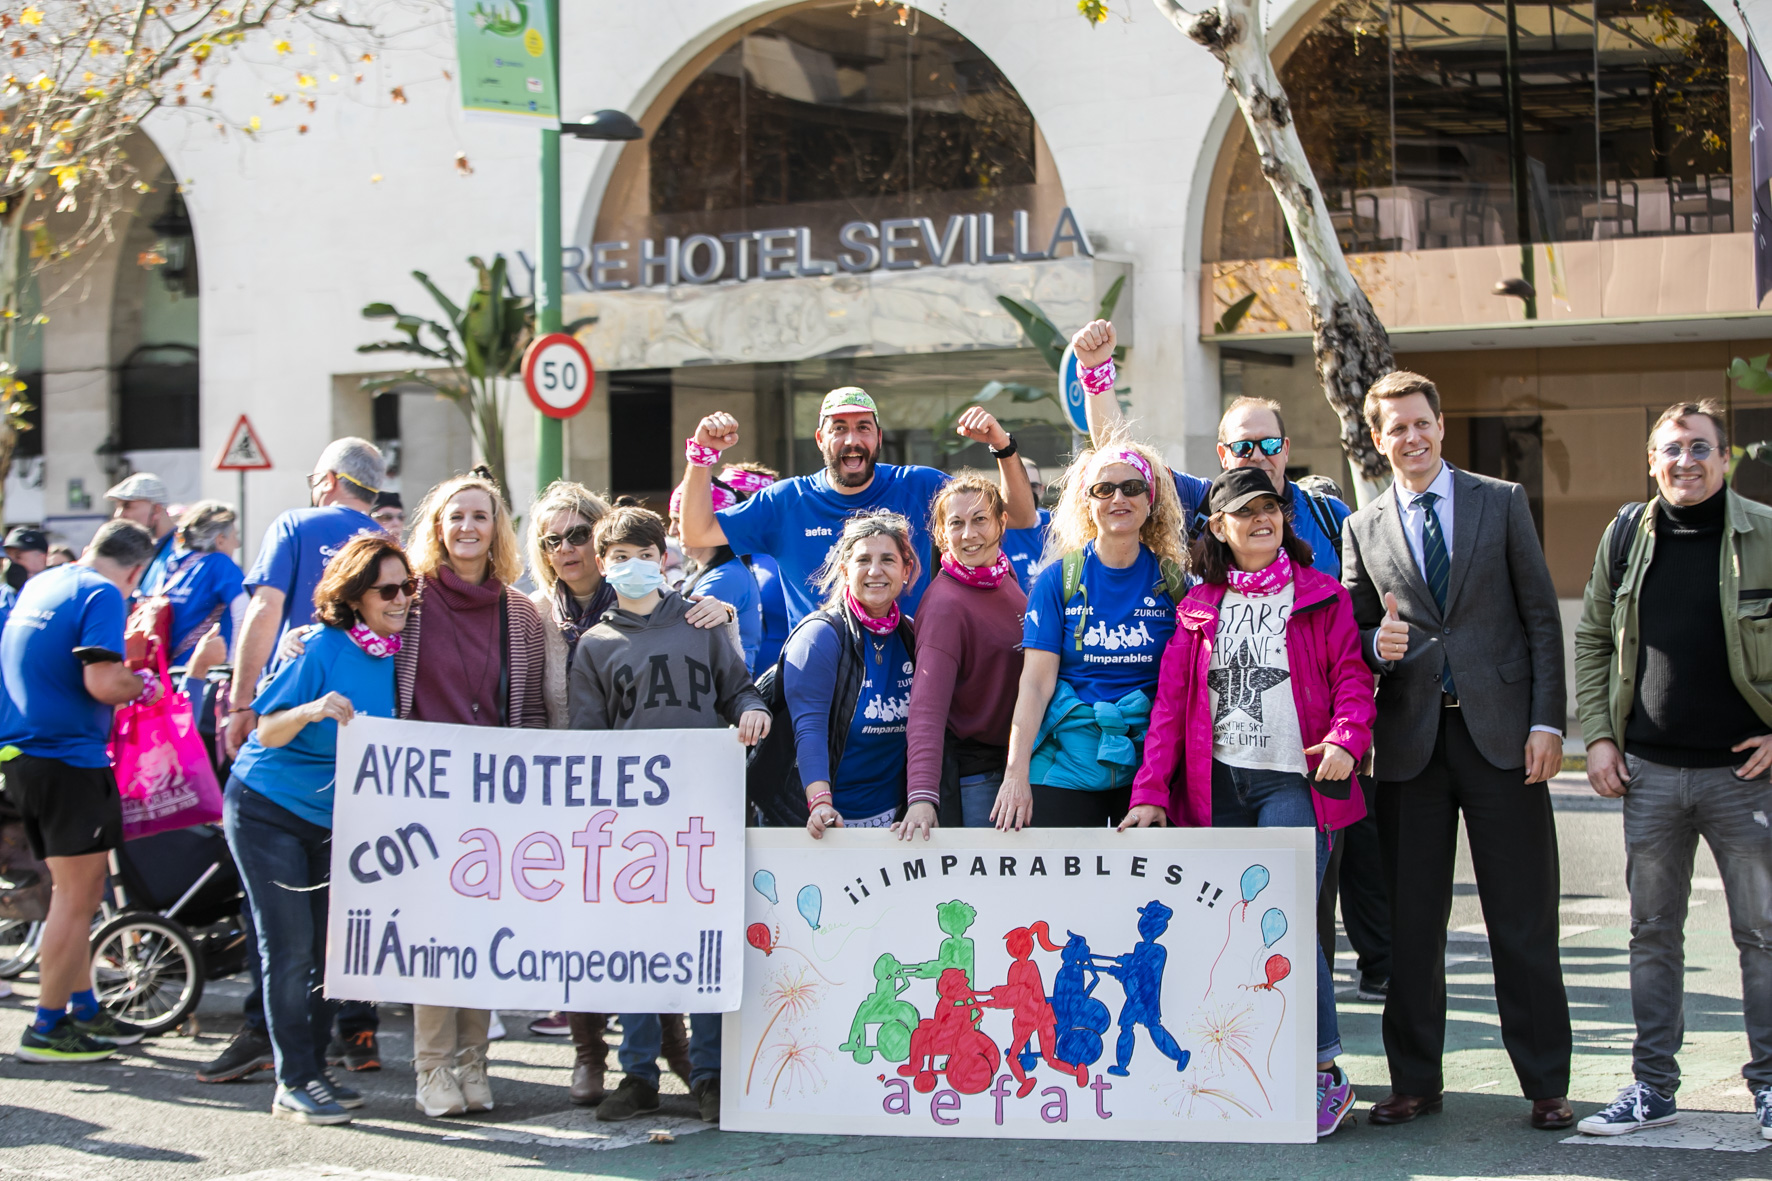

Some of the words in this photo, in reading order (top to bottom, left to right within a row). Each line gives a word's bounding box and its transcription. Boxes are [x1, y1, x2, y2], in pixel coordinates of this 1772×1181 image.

[639, 226, 833, 287] HOTEL
[838, 206, 1095, 273] SEVILLA
[543, 361, 577, 391] 50
[805, 527, 832, 537] aefat
[1133, 608, 1166, 618] ZURICH
[1083, 653, 1153, 665] #Imparables
[1212, 636, 1273, 668] ABOVE
[613, 654, 711, 720] GAP
[1228, 668, 1258, 709] US
[1239, 733, 1271, 748] LIMIT
[1249, 722, 1264, 733] SKY
[352, 743, 452, 799] AYRE
[473, 752, 671, 807] HOTELES
[348, 822, 440, 884] con
[449, 809, 715, 904] aefat
[489, 927, 723, 1004] Campeones!!!
[882, 1074, 1113, 1126] aefat
